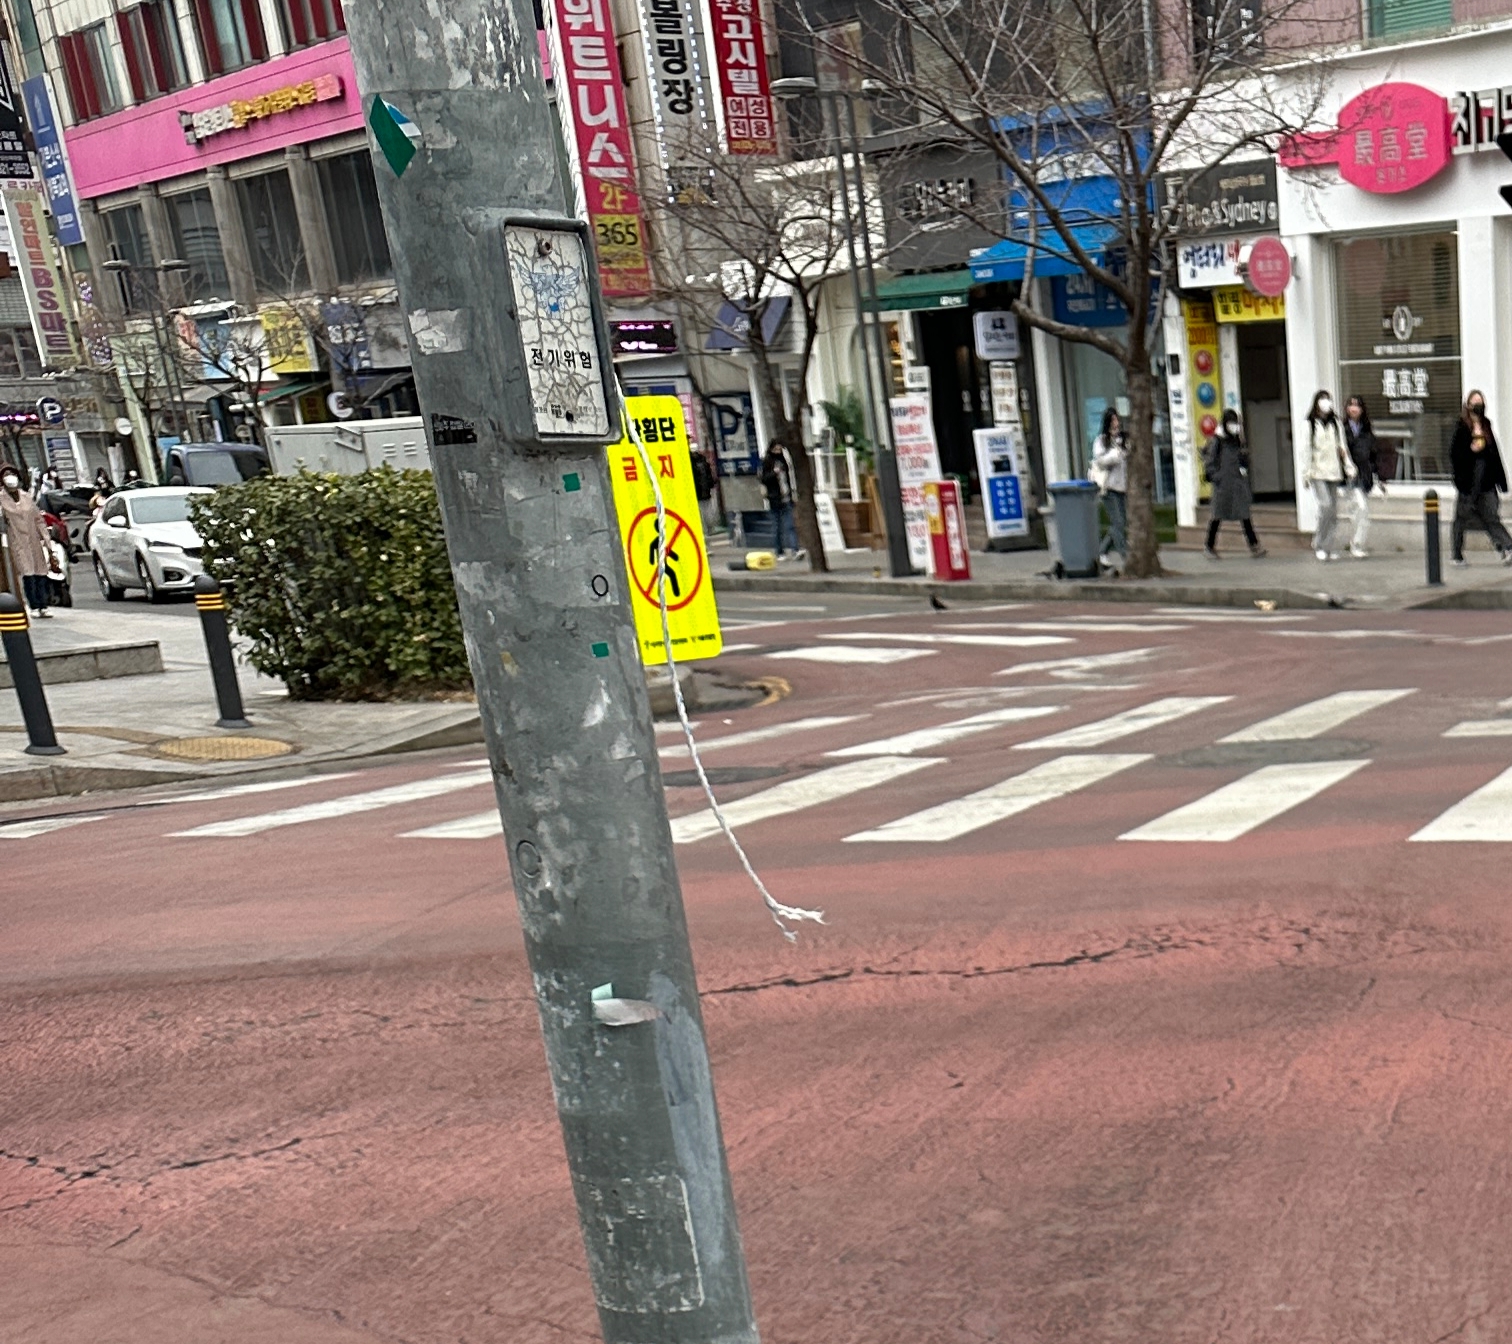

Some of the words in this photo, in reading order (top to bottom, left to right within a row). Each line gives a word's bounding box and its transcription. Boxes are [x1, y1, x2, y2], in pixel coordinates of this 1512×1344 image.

[651, 0, 694, 115] 볼링장
[728, 98, 767, 116] 여성
[731, 118, 770, 137] 전용
[599, 183, 628, 210] 2F
[596, 222, 638, 246] 365
[530, 347, 592, 369] 전기위험
